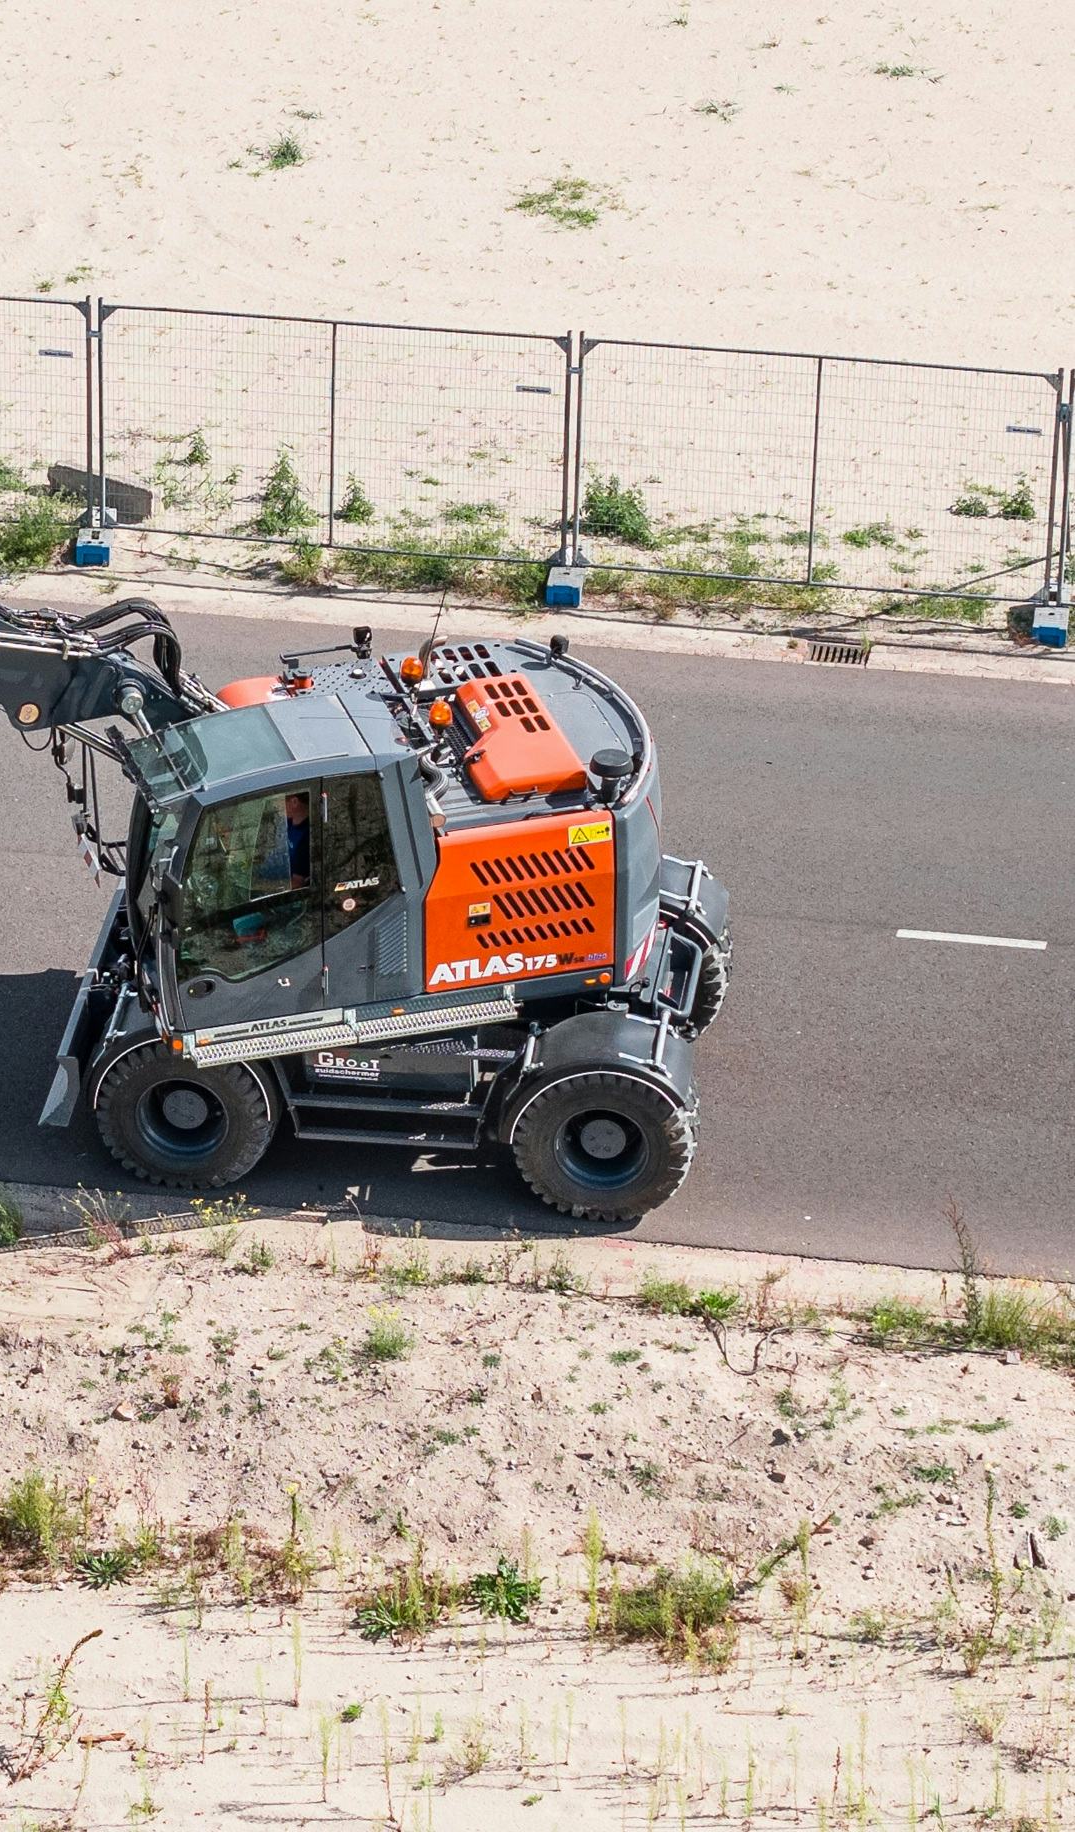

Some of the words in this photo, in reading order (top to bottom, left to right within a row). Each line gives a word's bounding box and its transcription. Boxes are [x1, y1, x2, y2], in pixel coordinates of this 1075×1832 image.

[345, 877, 380, 890] ATLAS
[428, 952, 525, 985] ATLAS
[250, 1019, 288, 1033] ATLAS
